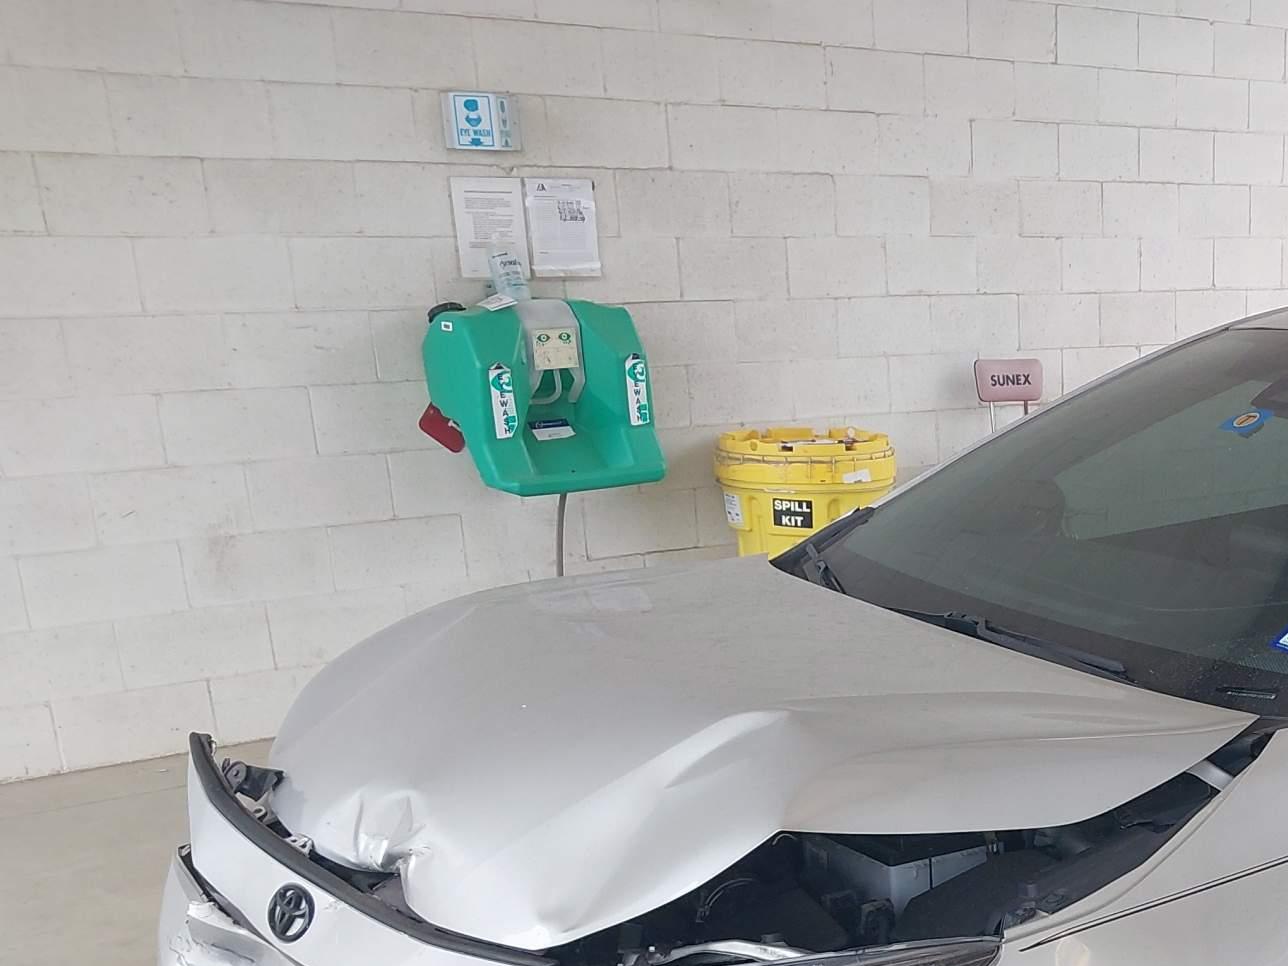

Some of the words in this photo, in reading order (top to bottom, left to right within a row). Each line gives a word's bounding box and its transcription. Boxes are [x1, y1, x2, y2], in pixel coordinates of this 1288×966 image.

[460, 128, 471, 137] EYE
[990, 374, 1032, 387] SUNEX
[774, 499, 811, 512] SPILL
[781, 514, 804, 527] KIT
